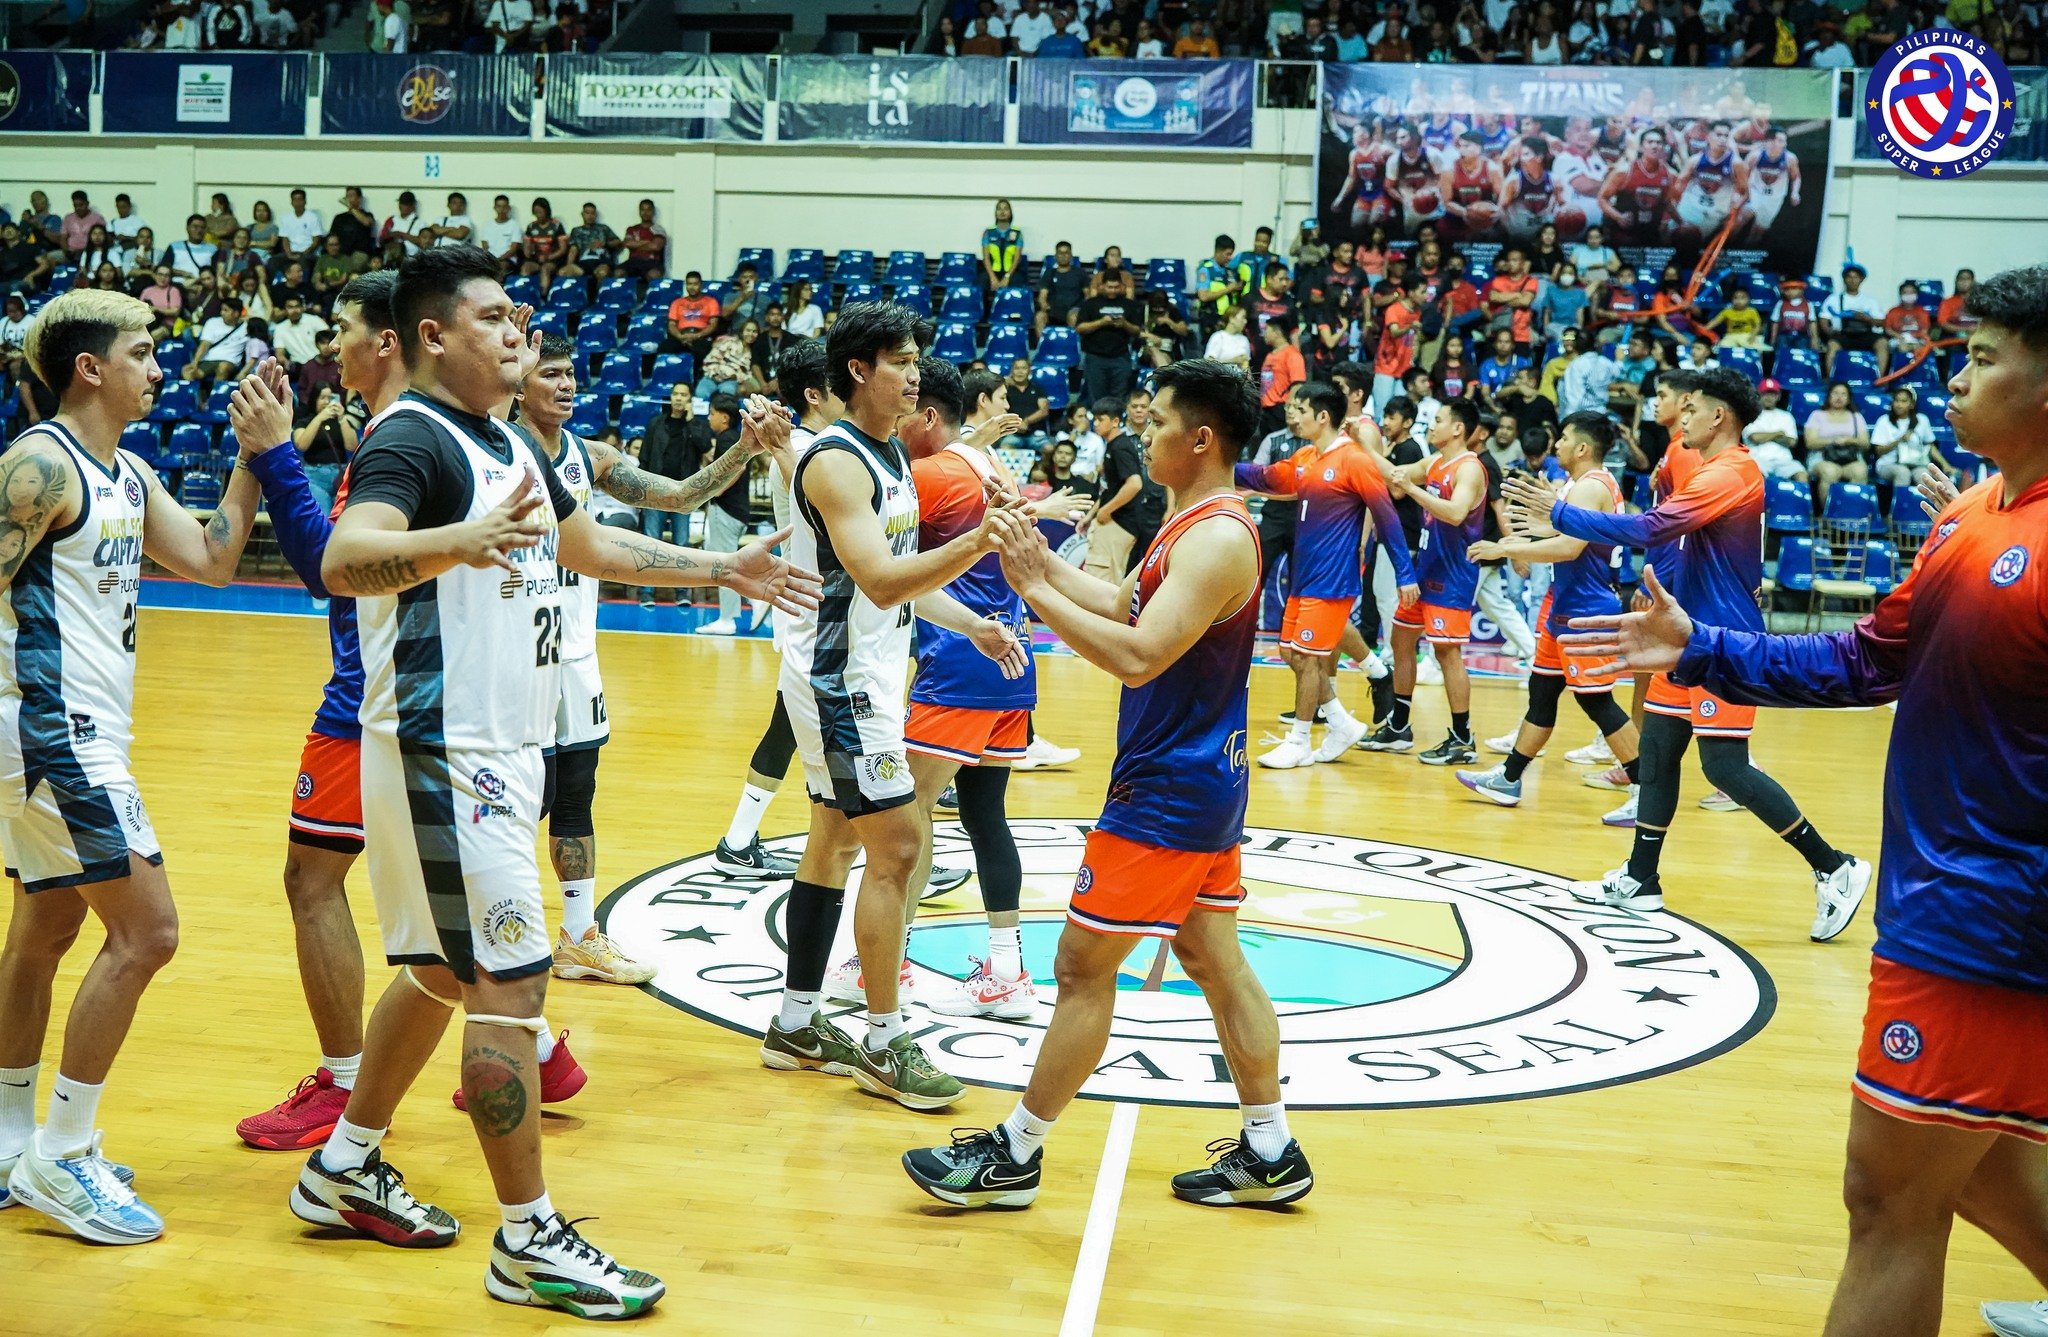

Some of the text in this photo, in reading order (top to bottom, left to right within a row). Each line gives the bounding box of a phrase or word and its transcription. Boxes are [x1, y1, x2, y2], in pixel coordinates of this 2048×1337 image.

[1520, 82, 1625, 114] TITANS
[590, 691, 607, 726] 12
[864, 758, 877, 782] NUEVA
[125, 805, 142, 832] NUEVA
[486, 898, 514, 917] ECIJA
[1353, 851, 1721, 979] QUEZON
[482, 917, 497, 947] NUEVA
[1346, 1018, 1665, 1083] SEAL
